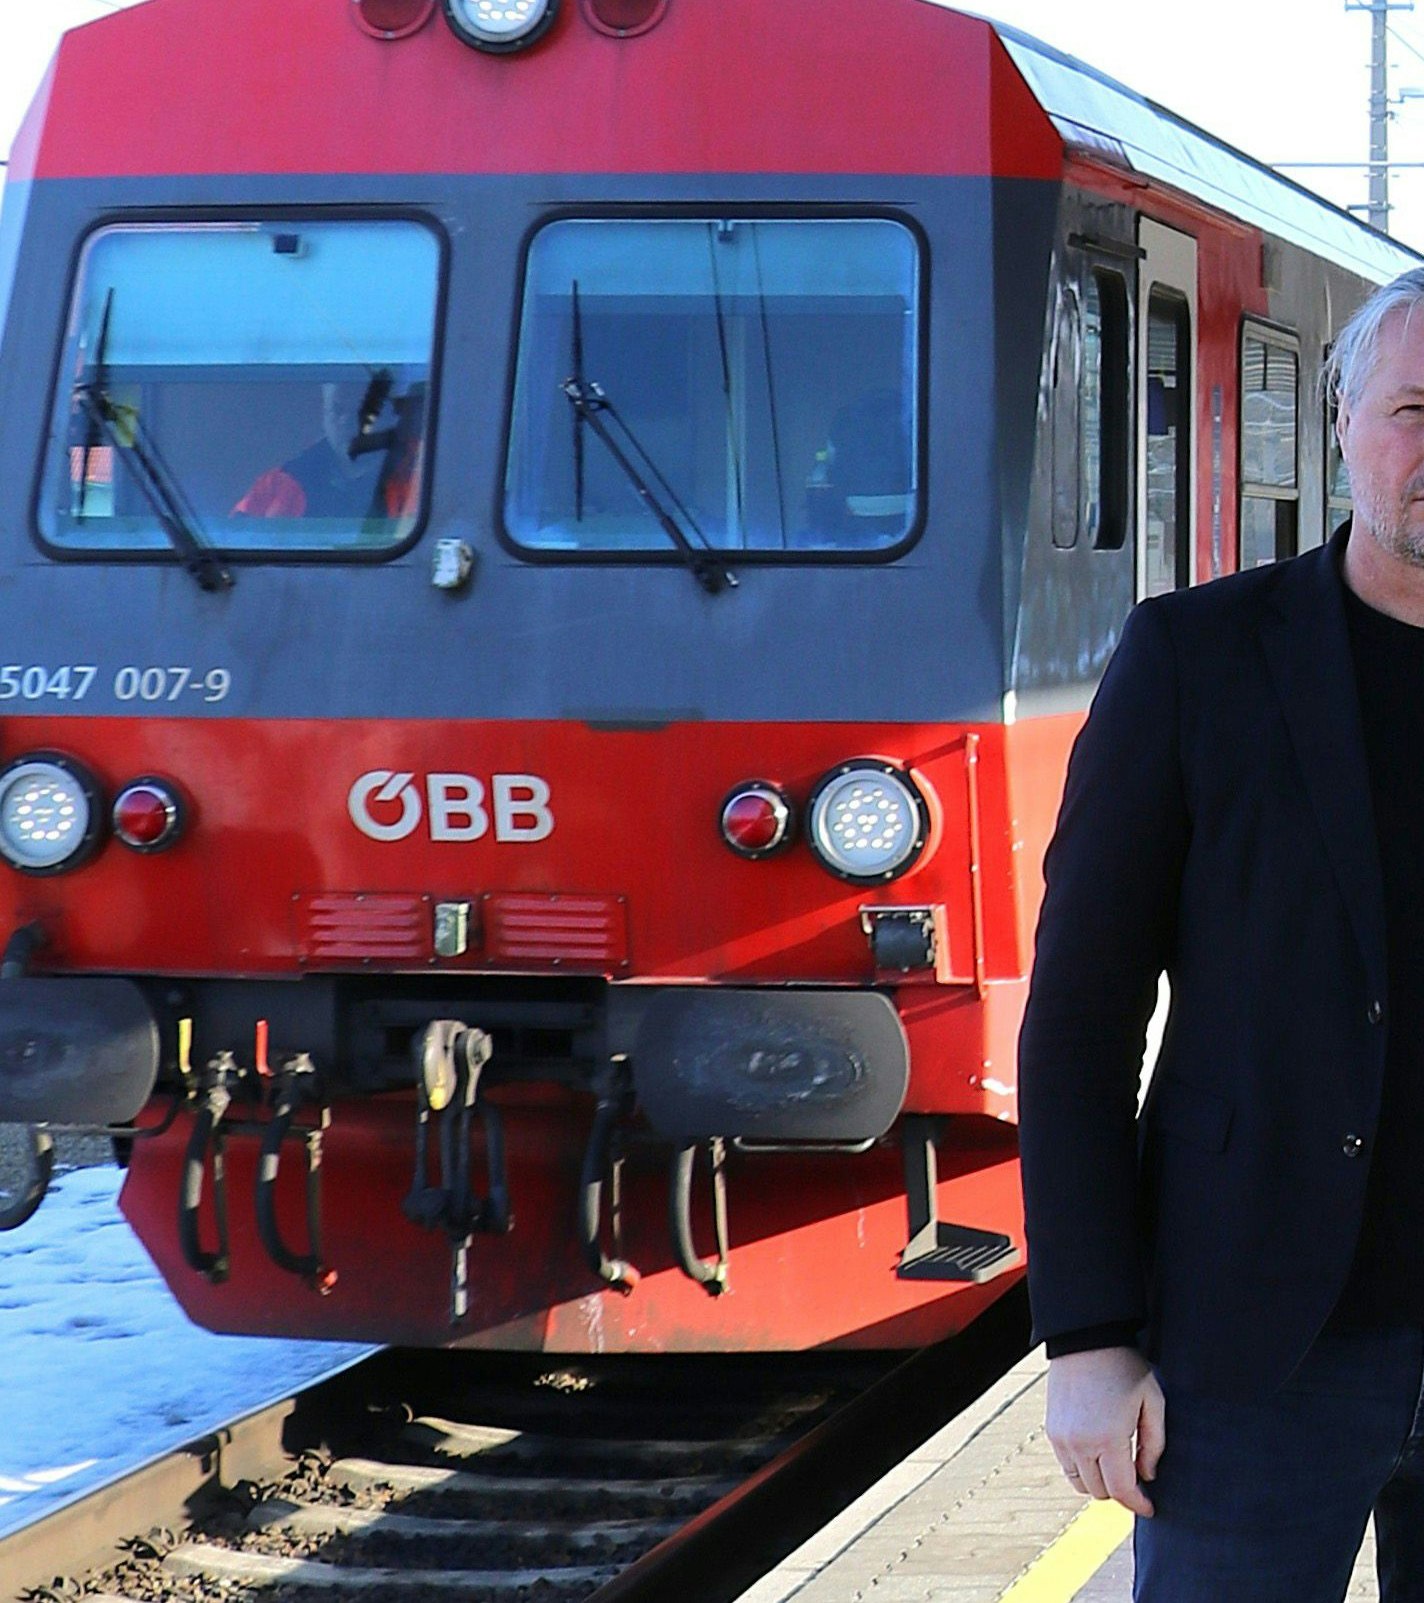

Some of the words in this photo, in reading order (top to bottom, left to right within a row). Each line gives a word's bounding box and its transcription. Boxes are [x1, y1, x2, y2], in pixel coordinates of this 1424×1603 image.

[0, 665, 98, 700] 5047
[113, 666, 231, 702] 007-9
[347, 770, 555, 842] ÖBB
